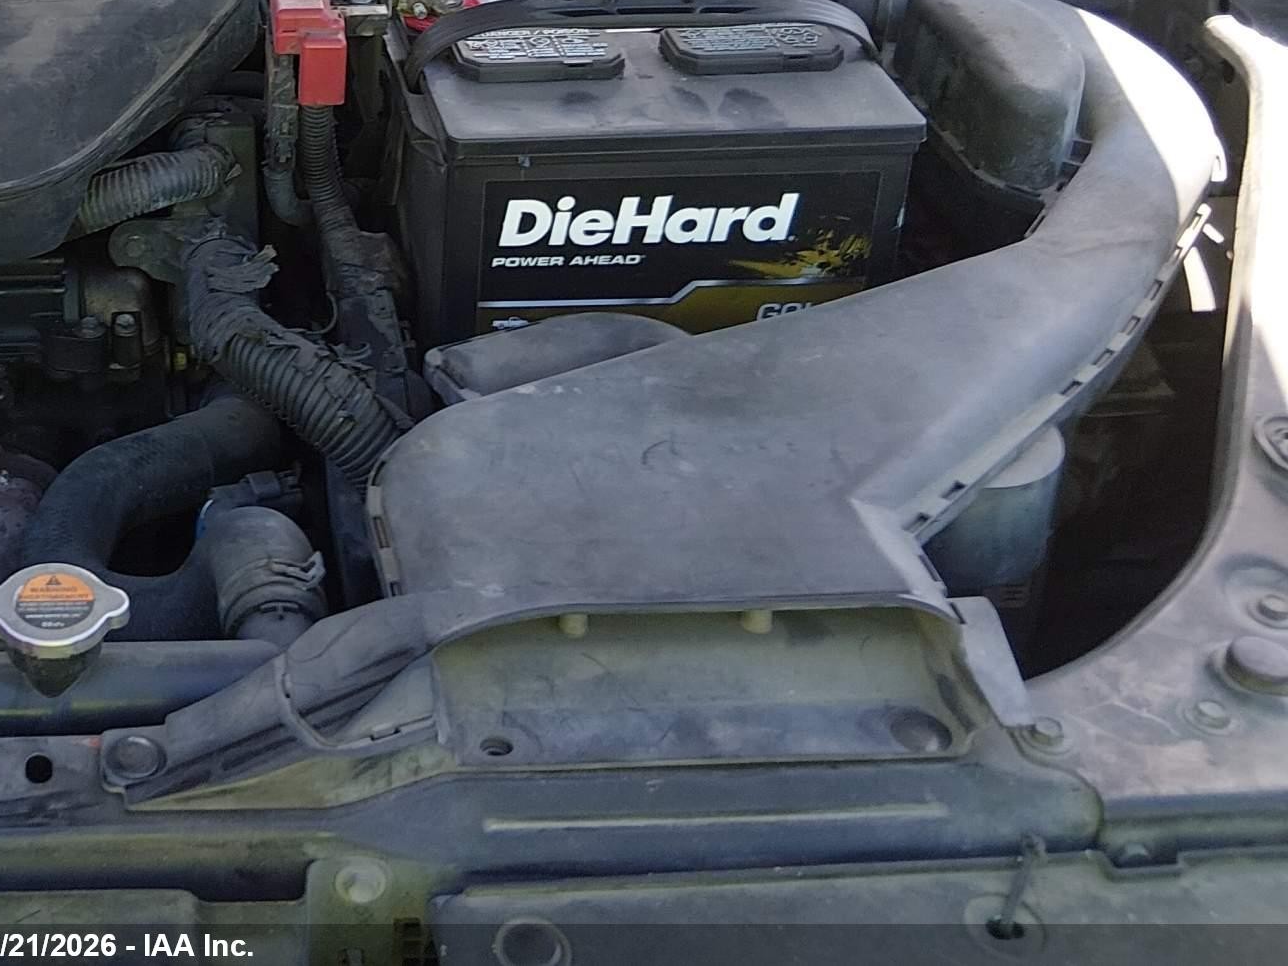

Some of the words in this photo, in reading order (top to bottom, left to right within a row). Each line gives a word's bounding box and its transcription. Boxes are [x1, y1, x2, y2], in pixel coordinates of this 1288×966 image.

[498, 192, 799, 247] DieHard
[491, 255, 564, 268] POWER
[569, 254, 641, 266] AHEAD
